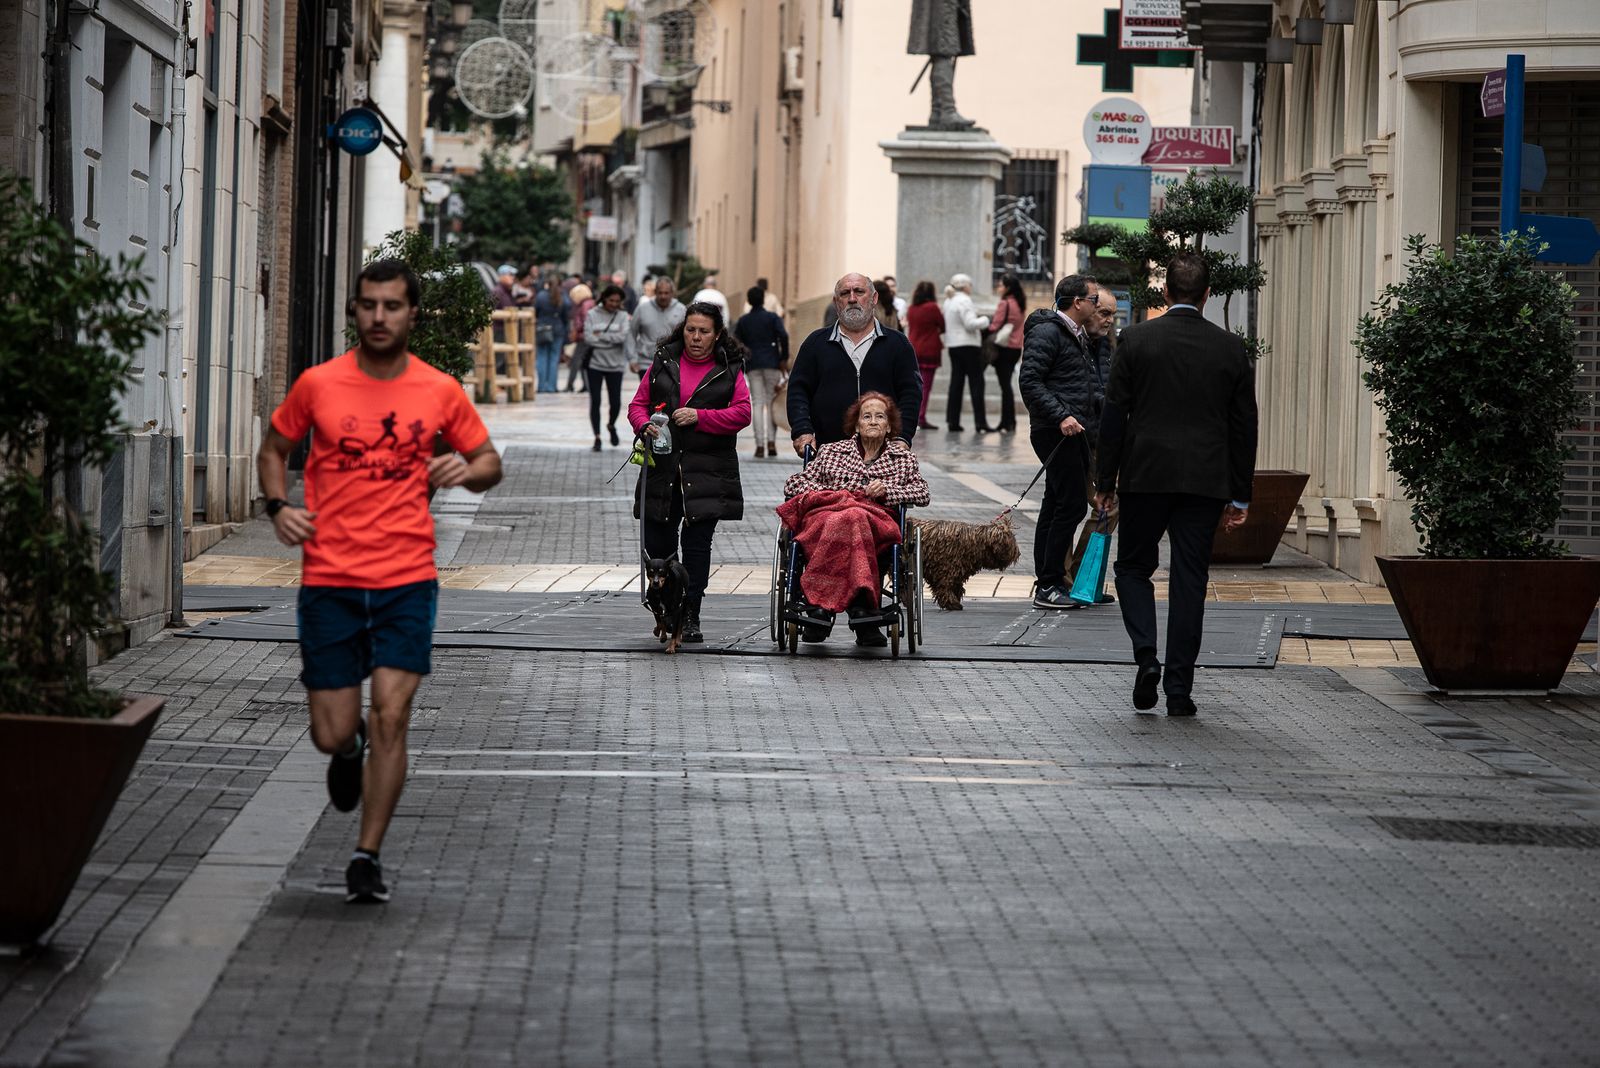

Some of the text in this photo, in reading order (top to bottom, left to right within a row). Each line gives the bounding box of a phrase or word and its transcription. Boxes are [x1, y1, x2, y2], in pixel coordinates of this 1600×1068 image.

[339, 128, 379, 139] DIGI
[1098, 125, 1137, 134] Abrimos
[1096, 134, 1114, 143] 365
[1151, 127, 1230, 150] UQUERIA
